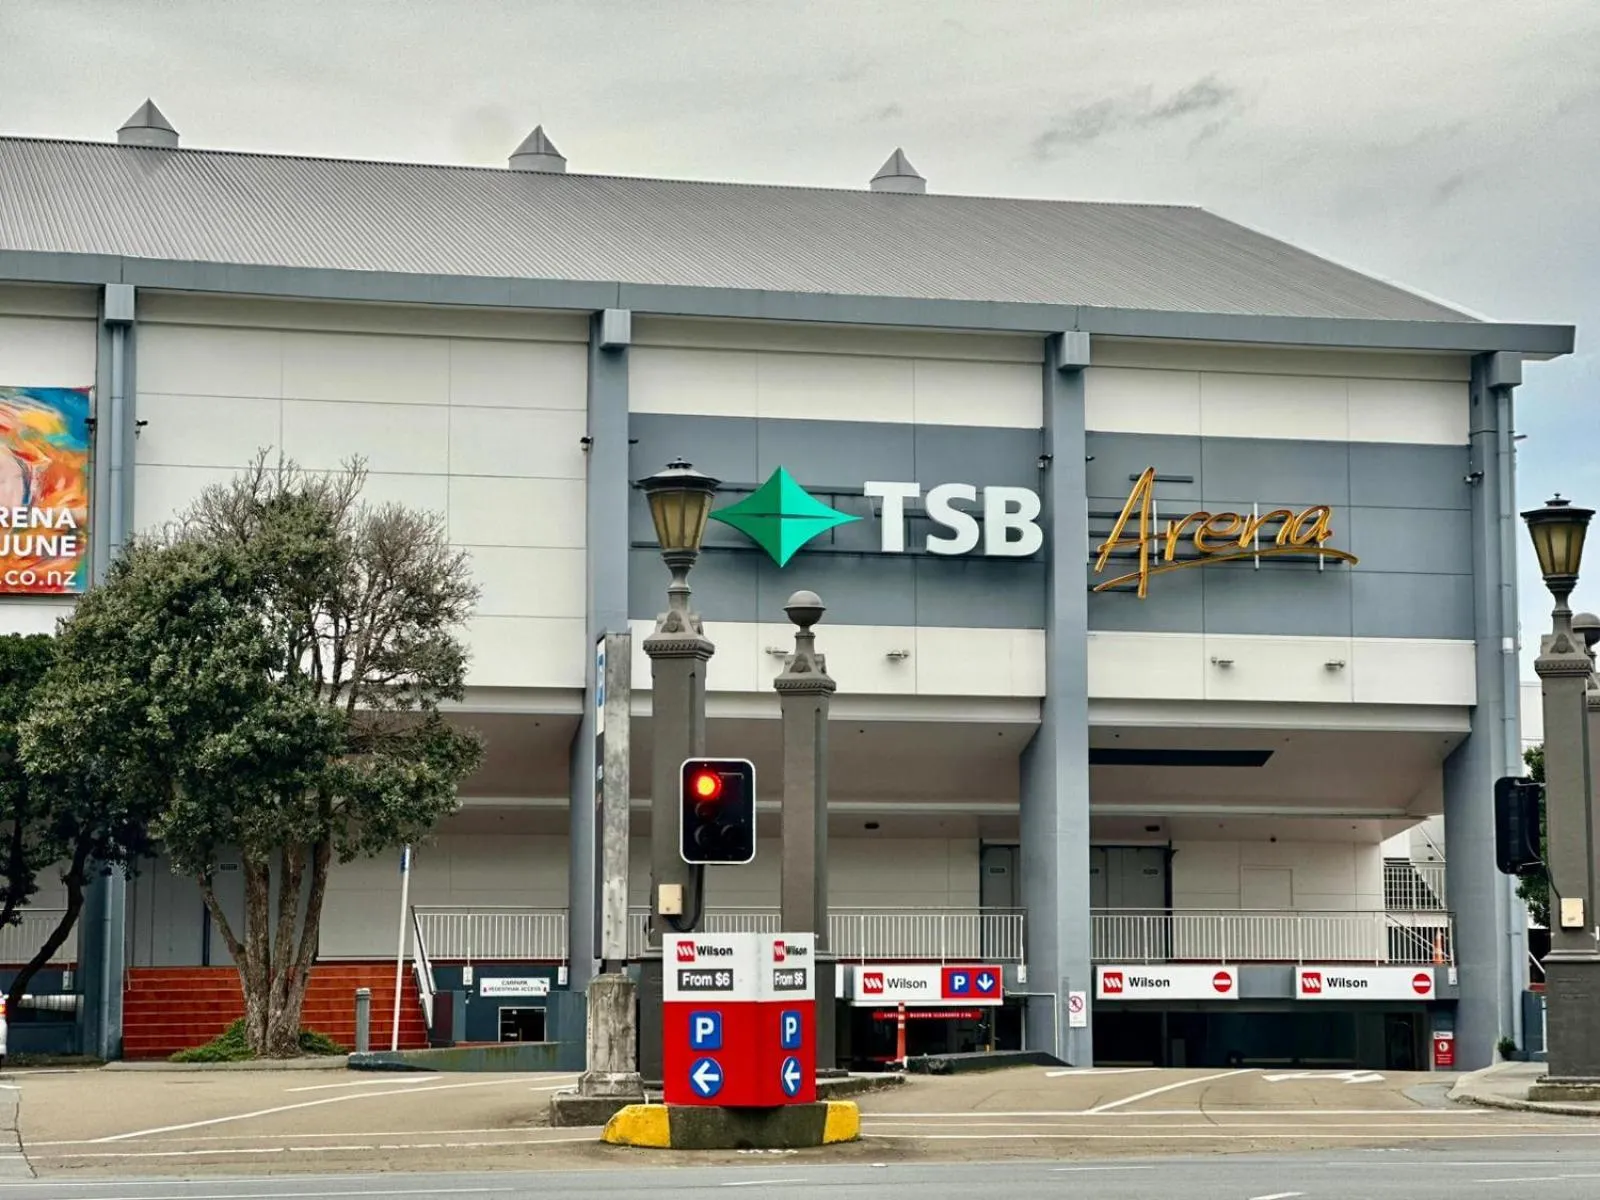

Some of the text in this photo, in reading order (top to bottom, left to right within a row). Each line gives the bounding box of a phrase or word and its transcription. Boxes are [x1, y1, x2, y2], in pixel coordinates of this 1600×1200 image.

[864, 481, 1044, 557] TSB
[1094, 466, 1358, 599] Arena
[0, 534, 77, 556] JUNE
[696, 945, 733, 956] Wilson
[785, 945, 807, 956] Wilson
[682, 971, 730, 987] From $6
[774, 971, 804, 986] From $6
[887, 975, 966, 990] Wilson P
[1128, 976, 1170, 988] Wilson
[1326, 977, 1368, 988] Wilson
[695, 1017, 714, 1043] P
[785, 1016, 797, 1043] P
